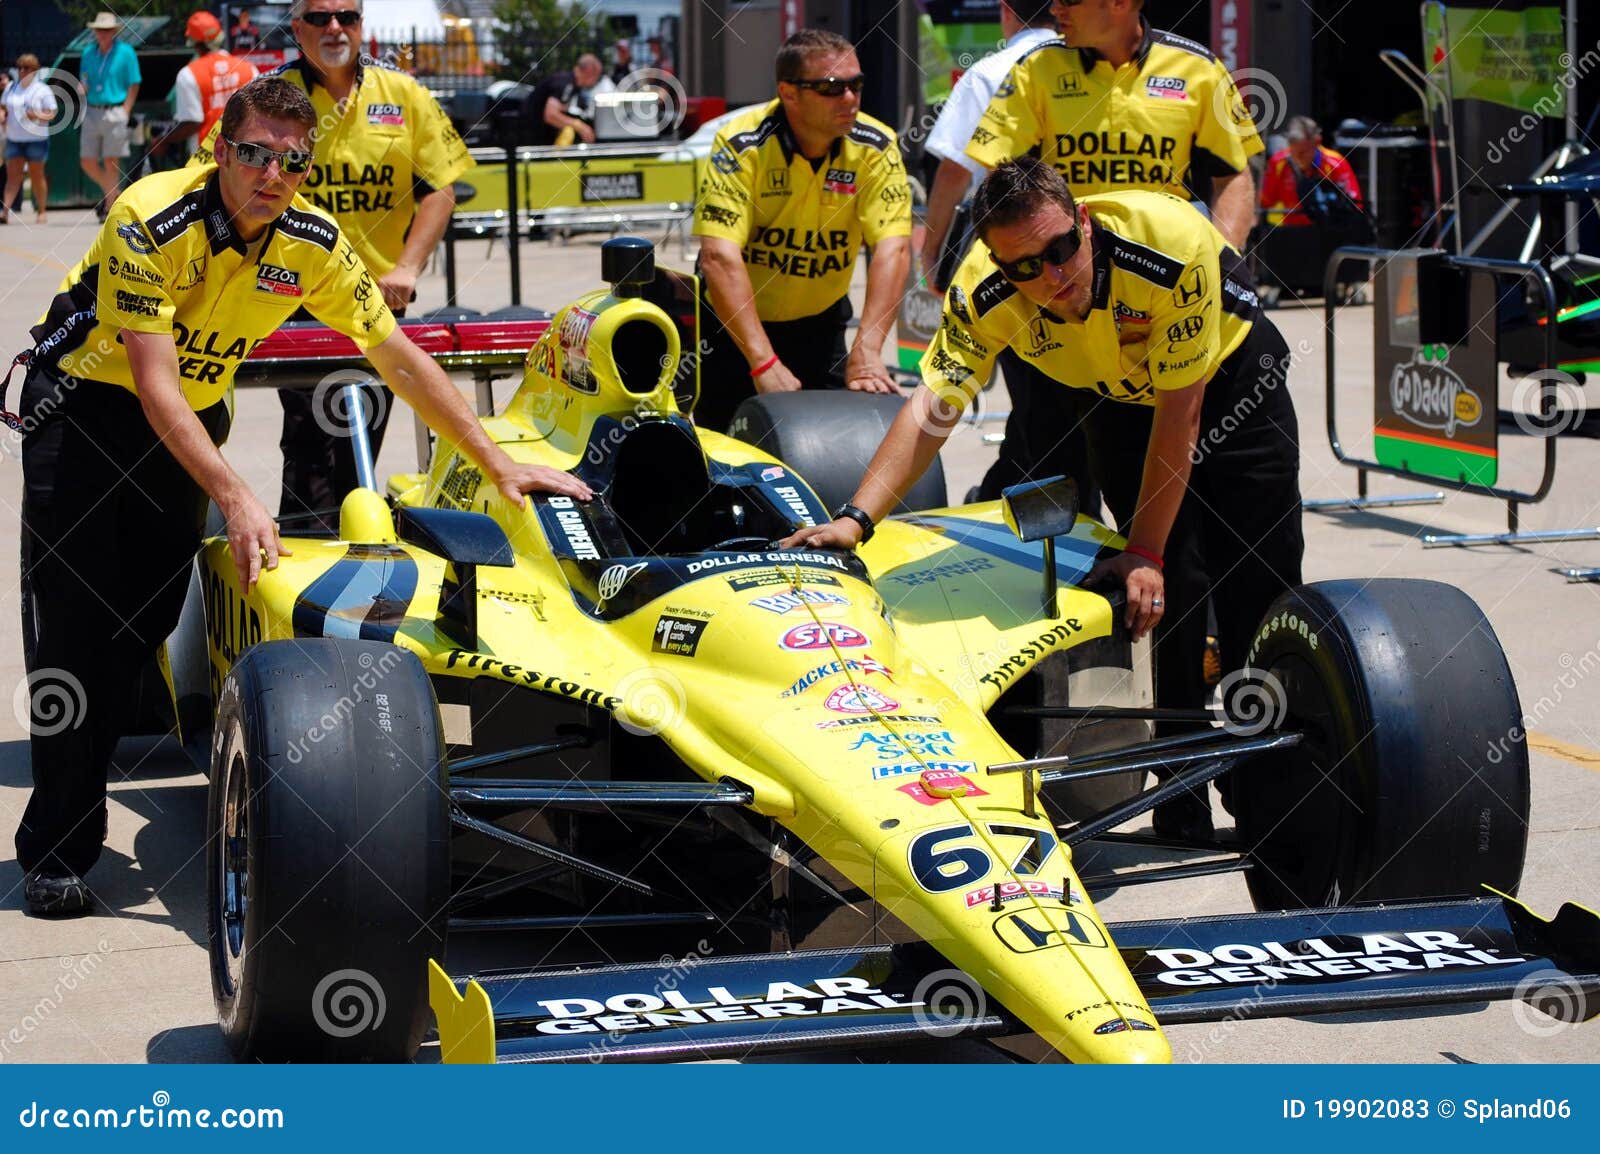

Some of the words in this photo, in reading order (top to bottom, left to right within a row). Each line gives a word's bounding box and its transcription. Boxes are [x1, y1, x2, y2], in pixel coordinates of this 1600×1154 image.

[1149, 78, 1183, 91] IZOD
[1056, 132, 1176, 159] DOLLAR
[300, 164, 395, 189] OLLAR
[280, 211, 334, 241] Firestone
[1114, 246, 1168, 275] Firestone
[686, 553, 762, 574] DOLLAR
[766, 552, 849, 571] GENERAL
[657, 619, 674, 649] $1
[670, 632, 686, 641] cards
[673, 621, 697, 634] Greeting
[793, 626, 859, 648] STP
[979, 617, 1083, 693] Firestone
[446, 648, 624, 711] Firestone
[780, 659, 860, 699] STACKER
[879, 761, 971, 777] Hefty
[908, 823, 1058, 894] 67
[1146, 930, 1475, 966] DOLLAR
[1156, 947, 1526, 987] GENERAL
[536, 976, 883, 1019] DOLLAR
[535, 993, 926, 1035] GENERAL
